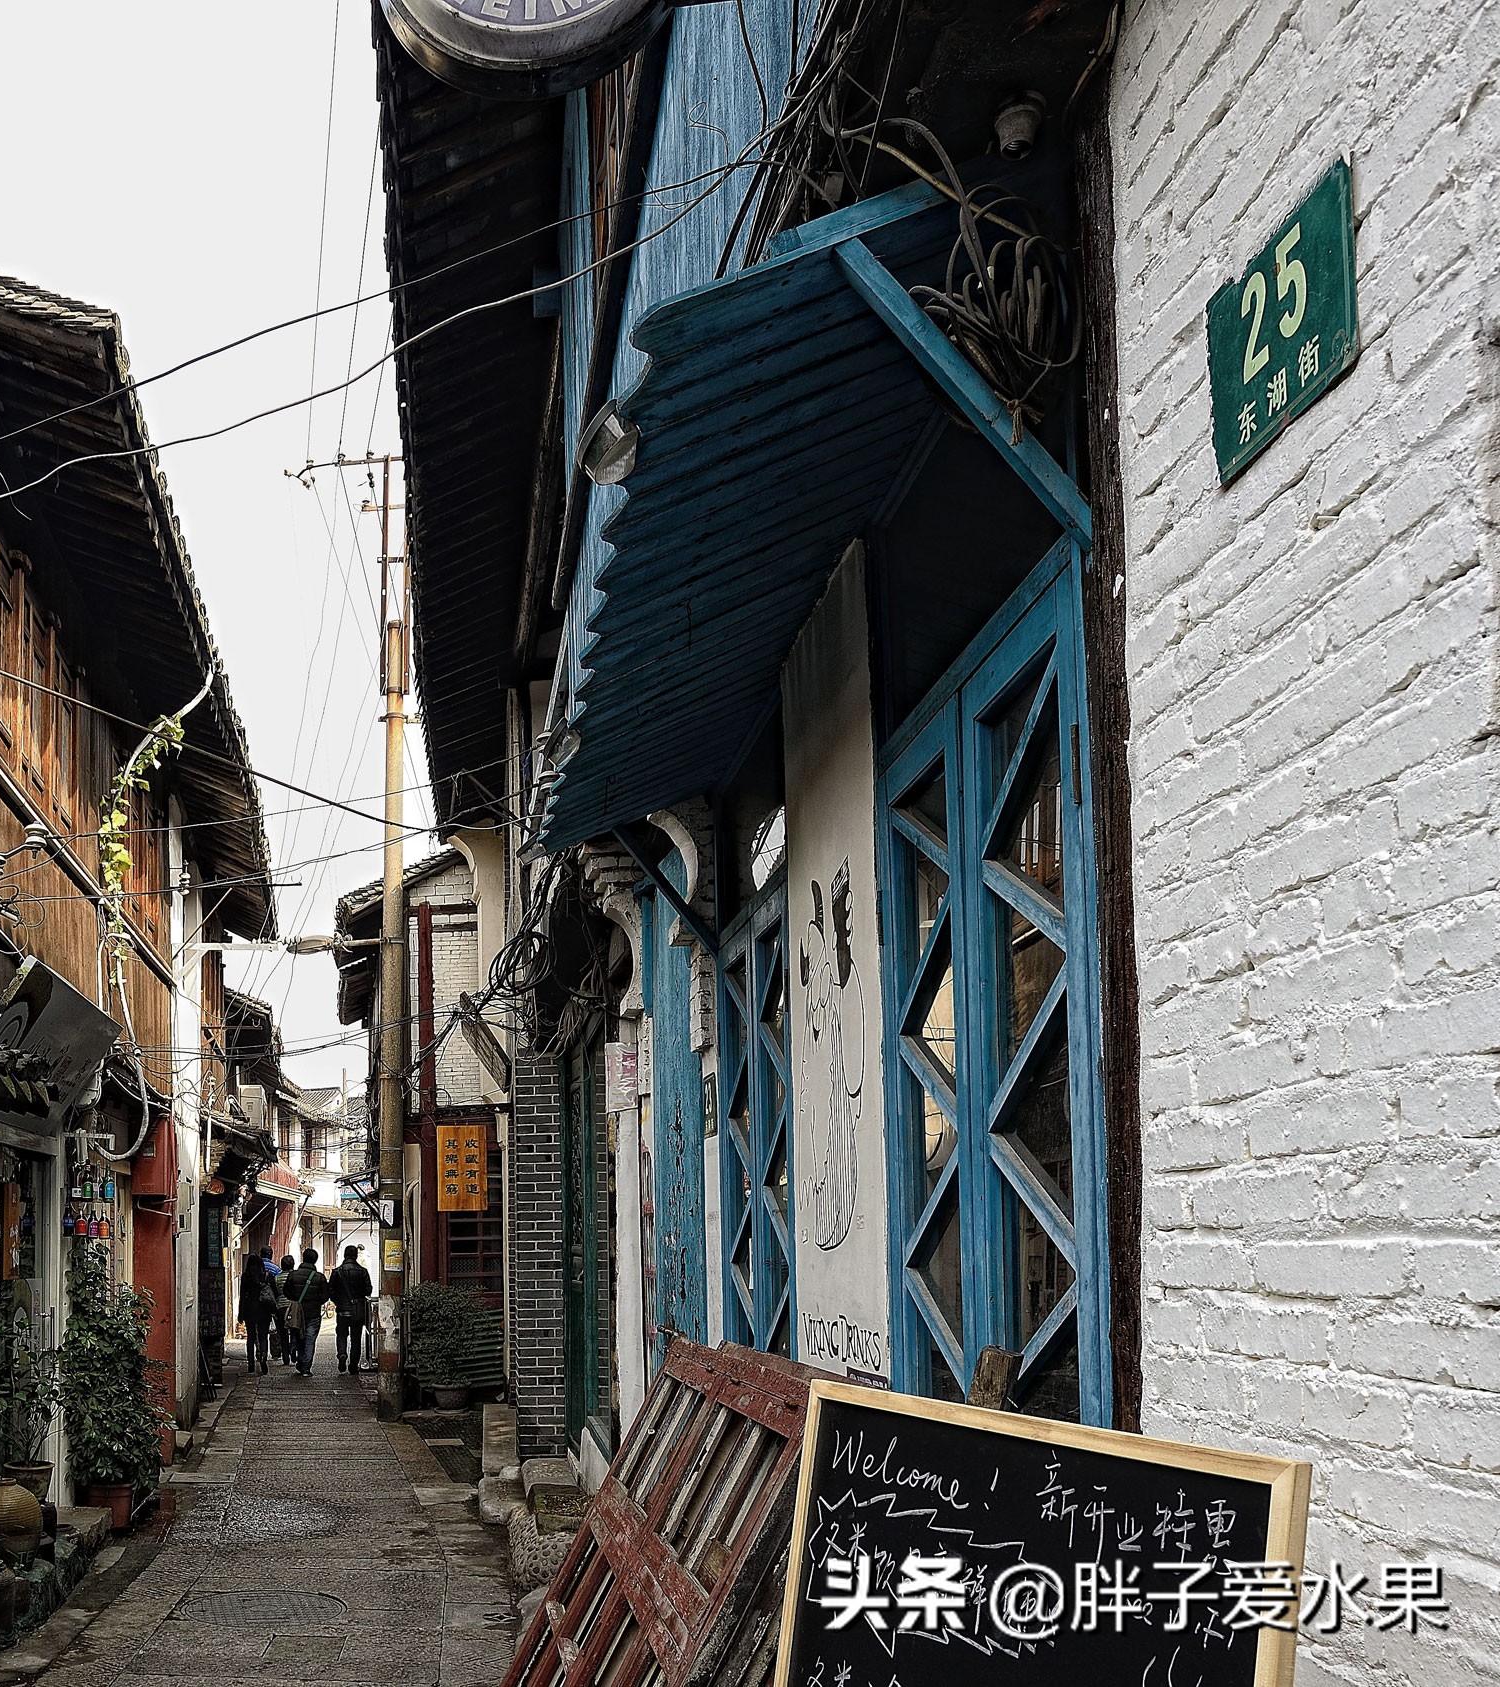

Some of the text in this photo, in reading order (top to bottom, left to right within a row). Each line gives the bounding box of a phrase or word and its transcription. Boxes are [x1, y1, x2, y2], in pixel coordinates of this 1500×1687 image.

[1241, 221, 1307, 385] 25
[1237, 334, 1320, 445] 东湖街
[704, 1081, 713, 1115] 23
[802, 1312, 881, 1372] VIKING DRINKS
